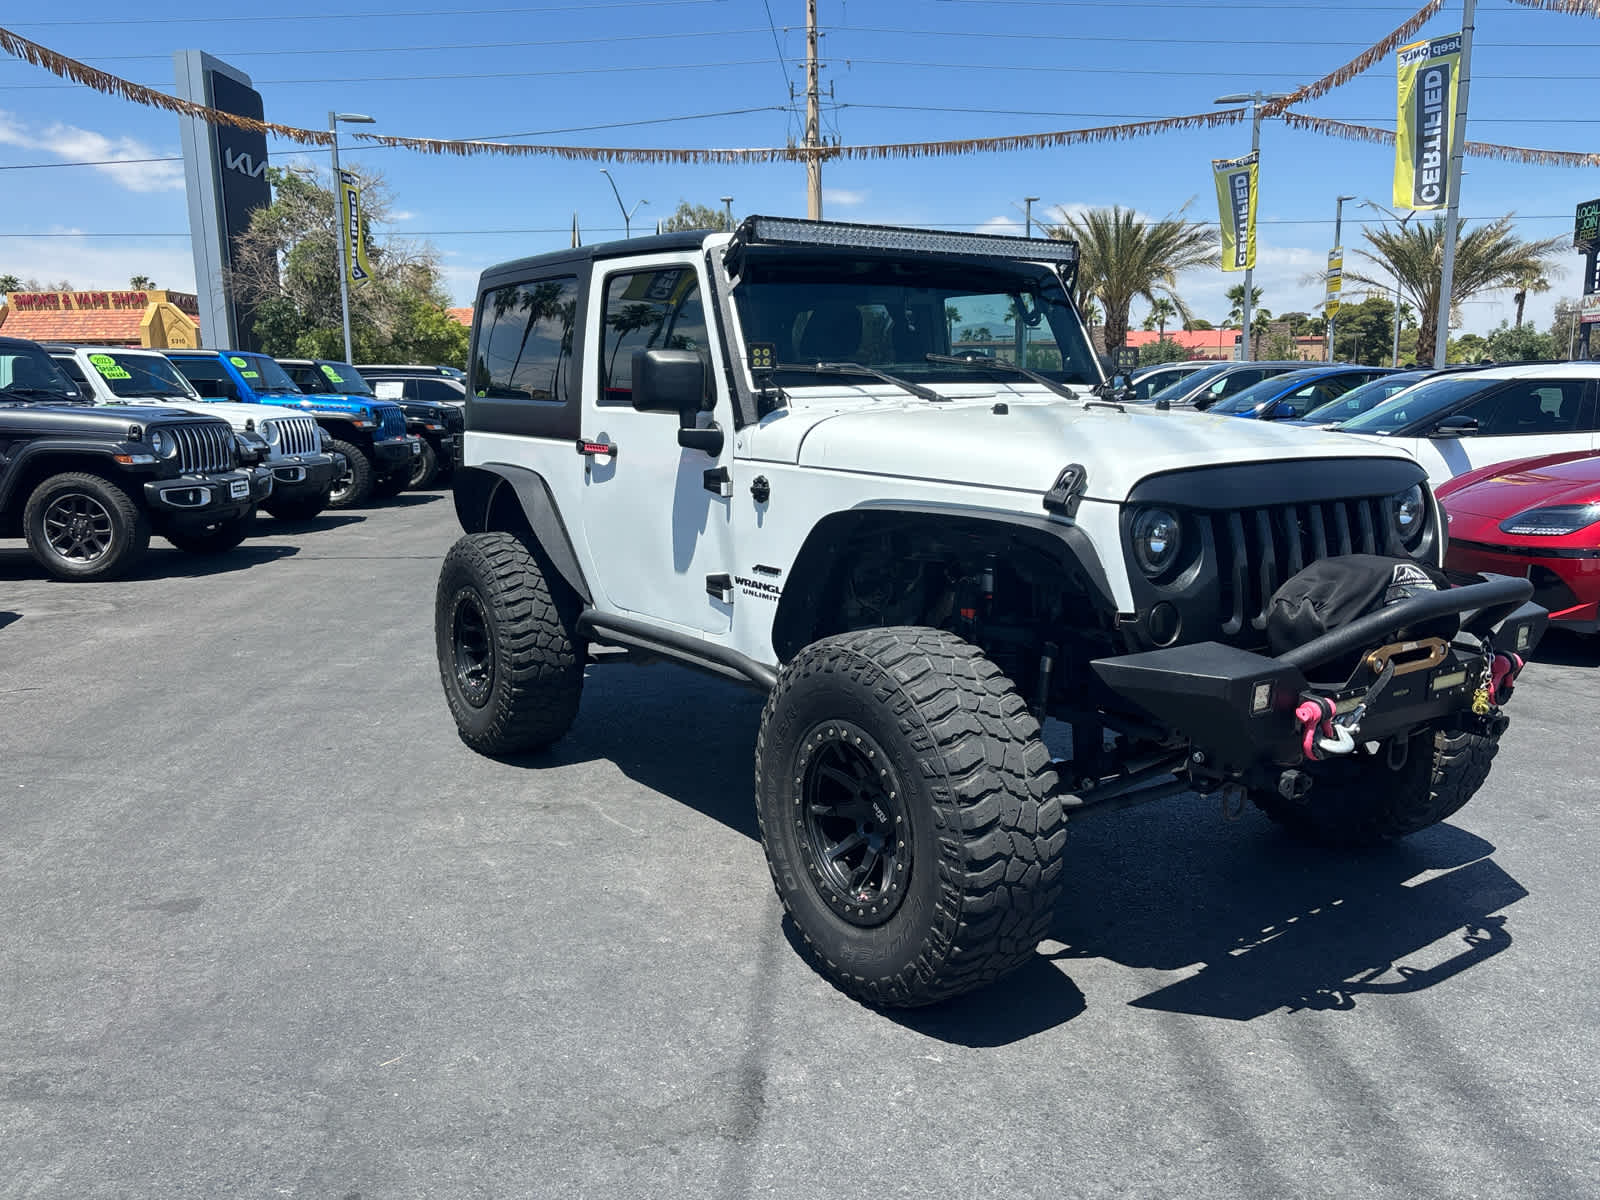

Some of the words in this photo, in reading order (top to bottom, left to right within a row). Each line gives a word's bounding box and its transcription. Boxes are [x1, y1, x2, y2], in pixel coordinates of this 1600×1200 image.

[13, 294, 58, 306] SMOKE
[62, 293, 71, 305] &
[74, 293, 107, 305] VAPE
[111, 292, 148, 304] SHOP
